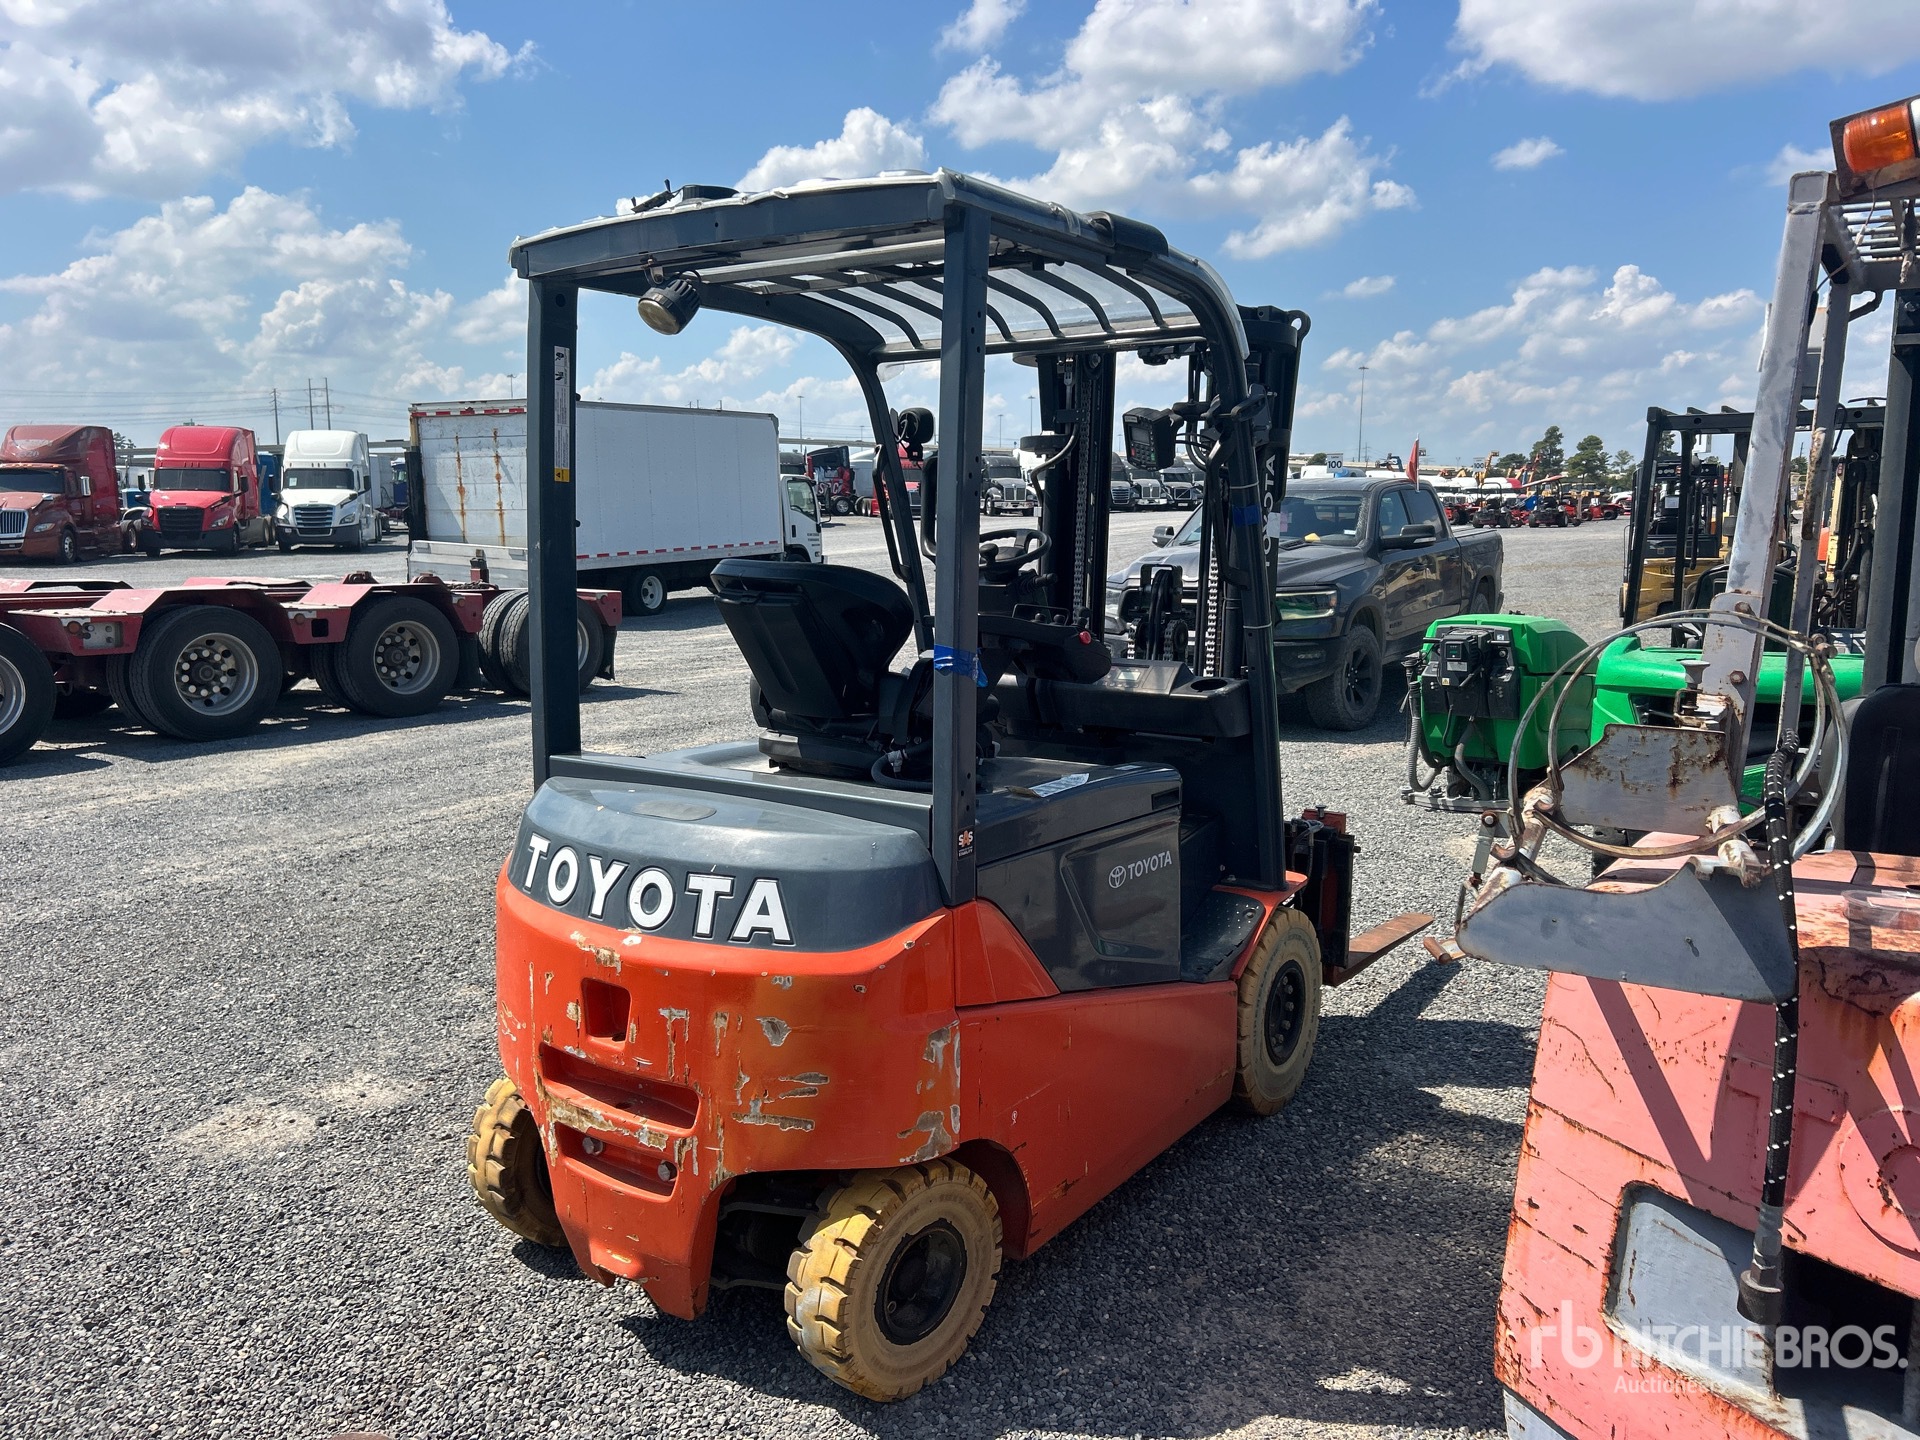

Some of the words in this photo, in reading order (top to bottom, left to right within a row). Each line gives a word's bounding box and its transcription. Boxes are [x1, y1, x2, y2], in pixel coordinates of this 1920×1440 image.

[1327, 460, 1343, 469] 100
[1127, 850, 1172, 880] TOYOTA
[524, 833, 791, 942] TOYOTA
